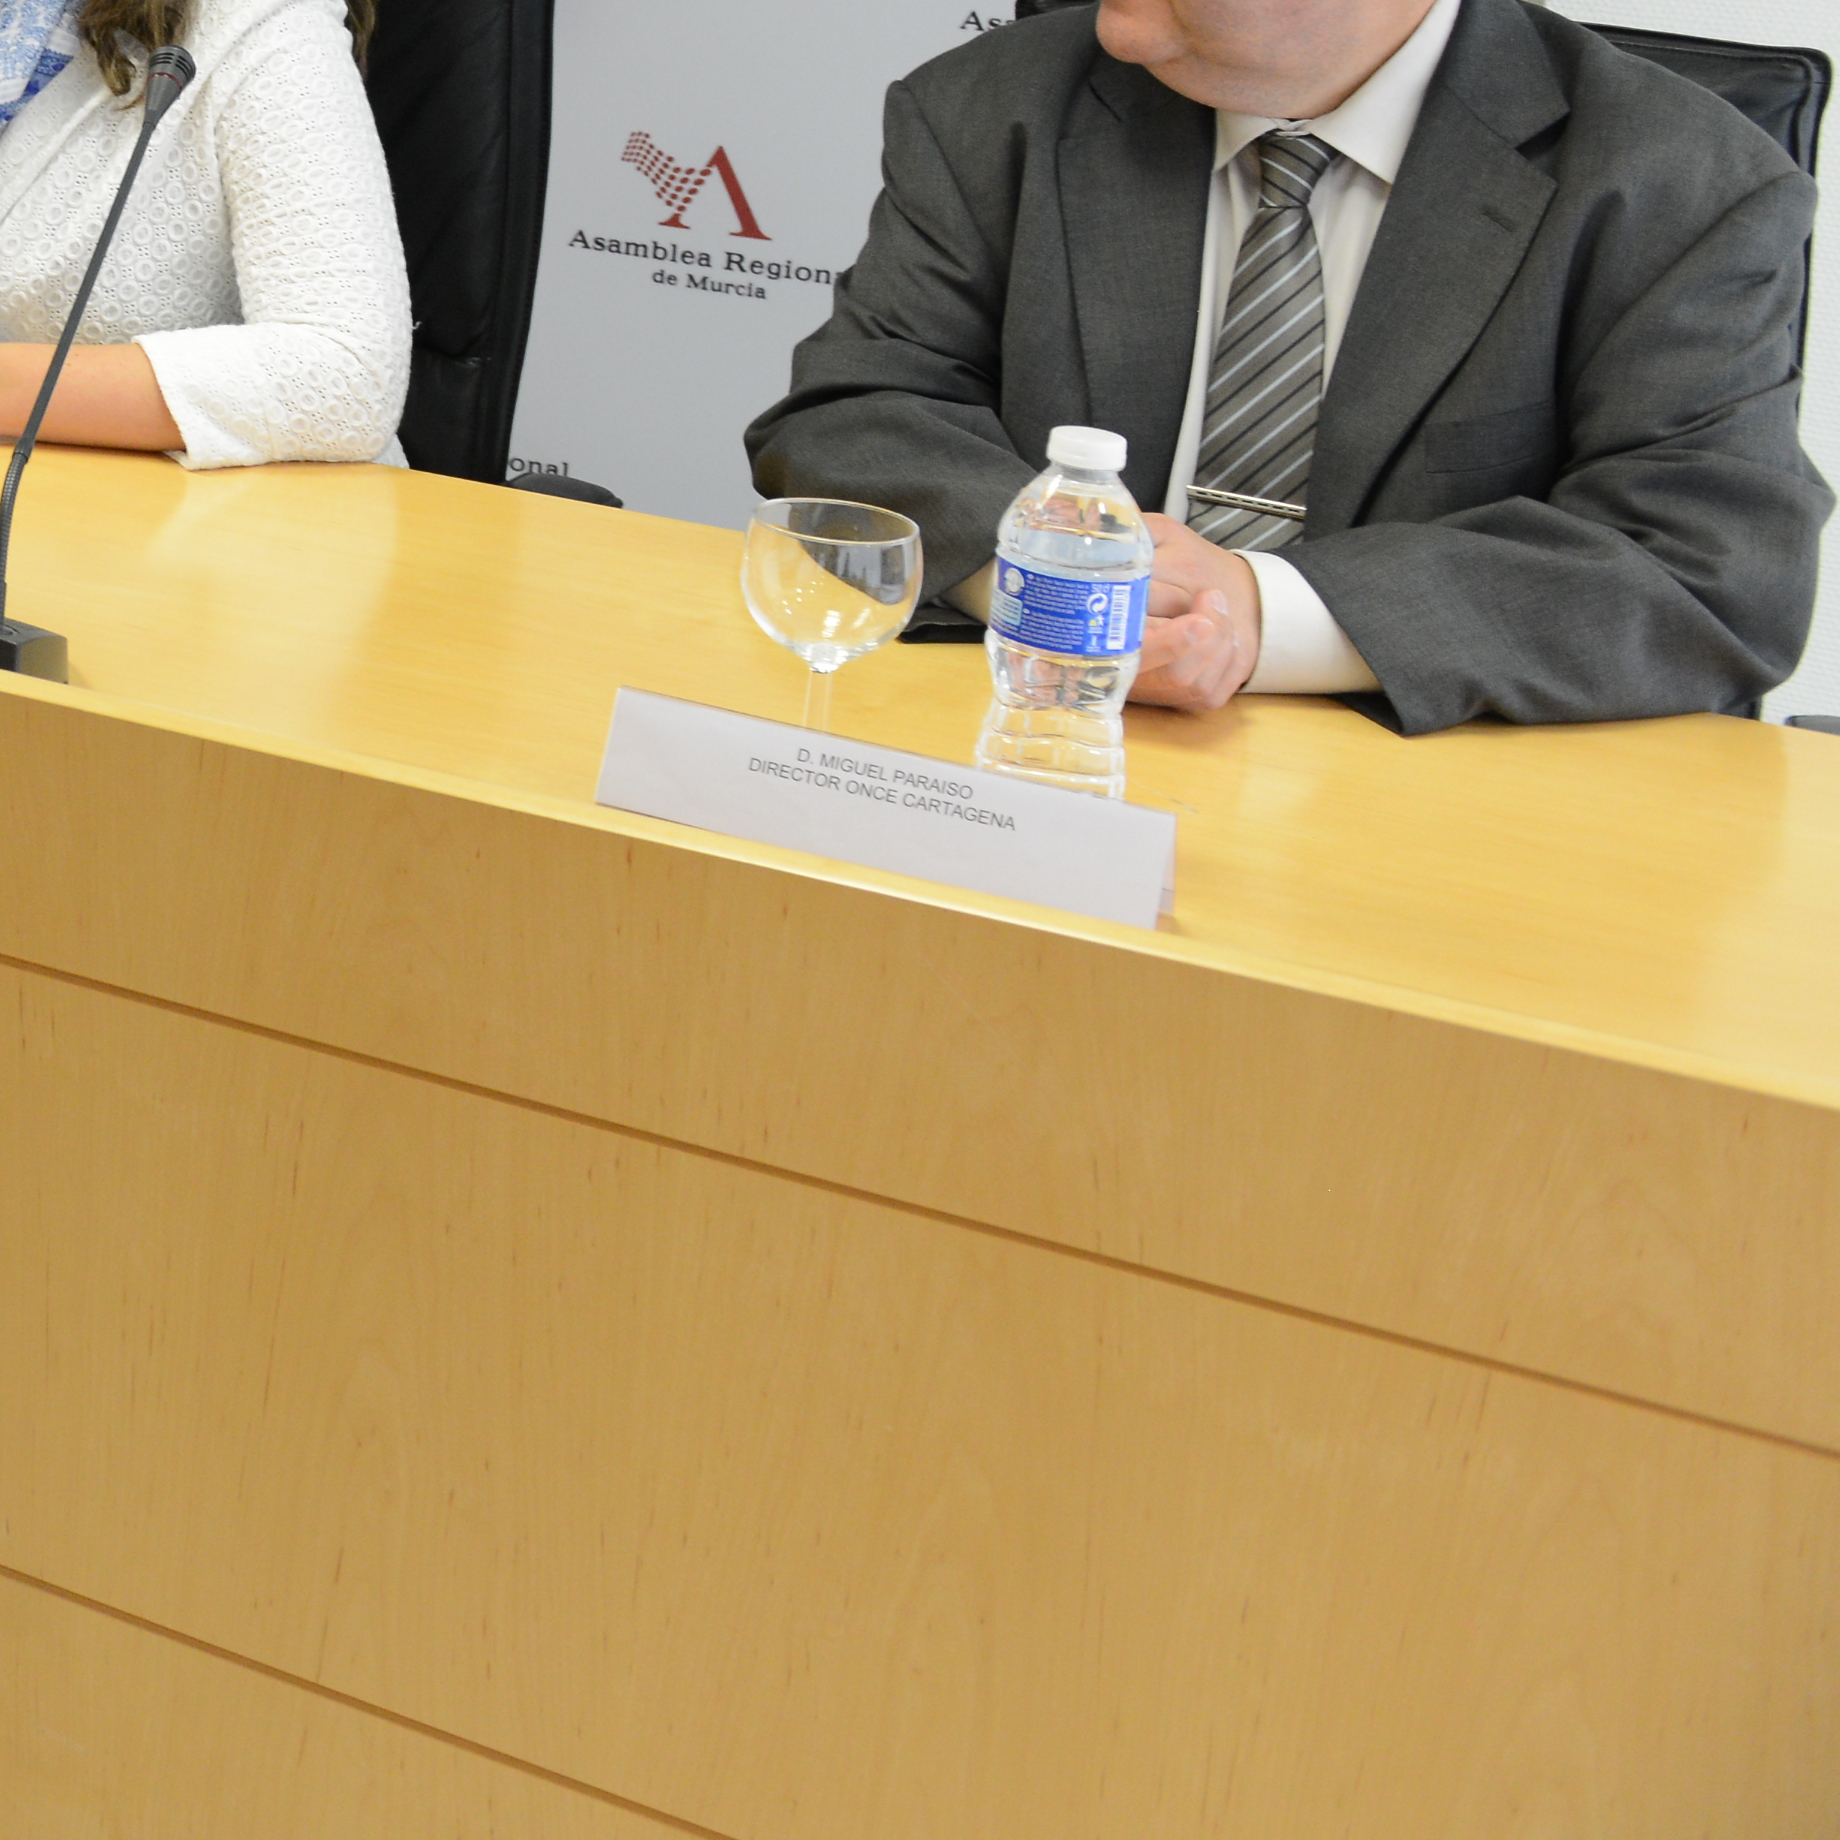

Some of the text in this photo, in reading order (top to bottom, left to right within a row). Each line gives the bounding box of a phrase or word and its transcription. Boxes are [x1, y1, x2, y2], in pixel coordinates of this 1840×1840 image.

[568, 229, 842, 285] Asamblea Region
[651, 269, 768, 300] de Murcia
[748, 757, 1017, 831] DIRECTOR ONCE CARTAGENA
[797, 748, 974, 800] D. MIGUEL PARAISO
